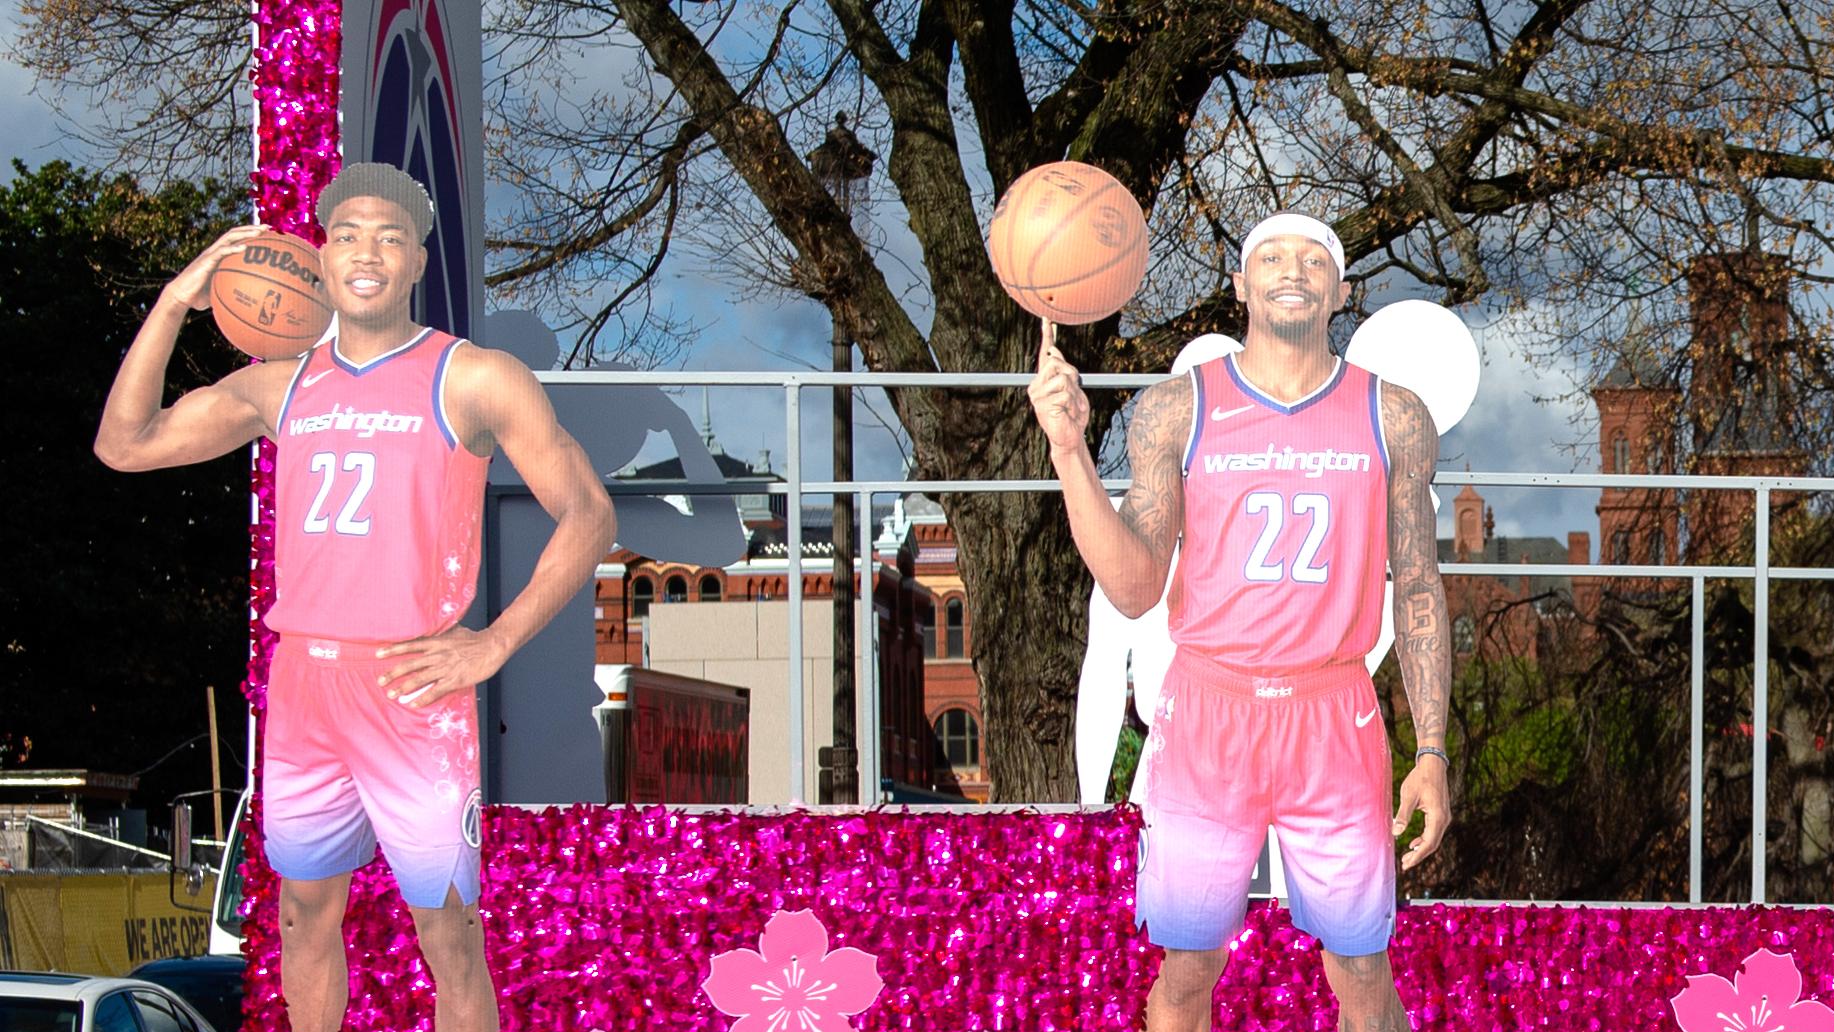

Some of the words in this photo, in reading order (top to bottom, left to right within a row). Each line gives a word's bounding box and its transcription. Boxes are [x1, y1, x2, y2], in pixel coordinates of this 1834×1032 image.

[243, 245, 324, 292] Wilson
[289, 403, 424, 438] washington
[1204, 443, 1371, 478] washington
[303, 451, 377, 537] 22
[1243, 491, 1330, 584] 22
[124, 918, 150, 962] WE
[152, 917, 179, 959] ARE
